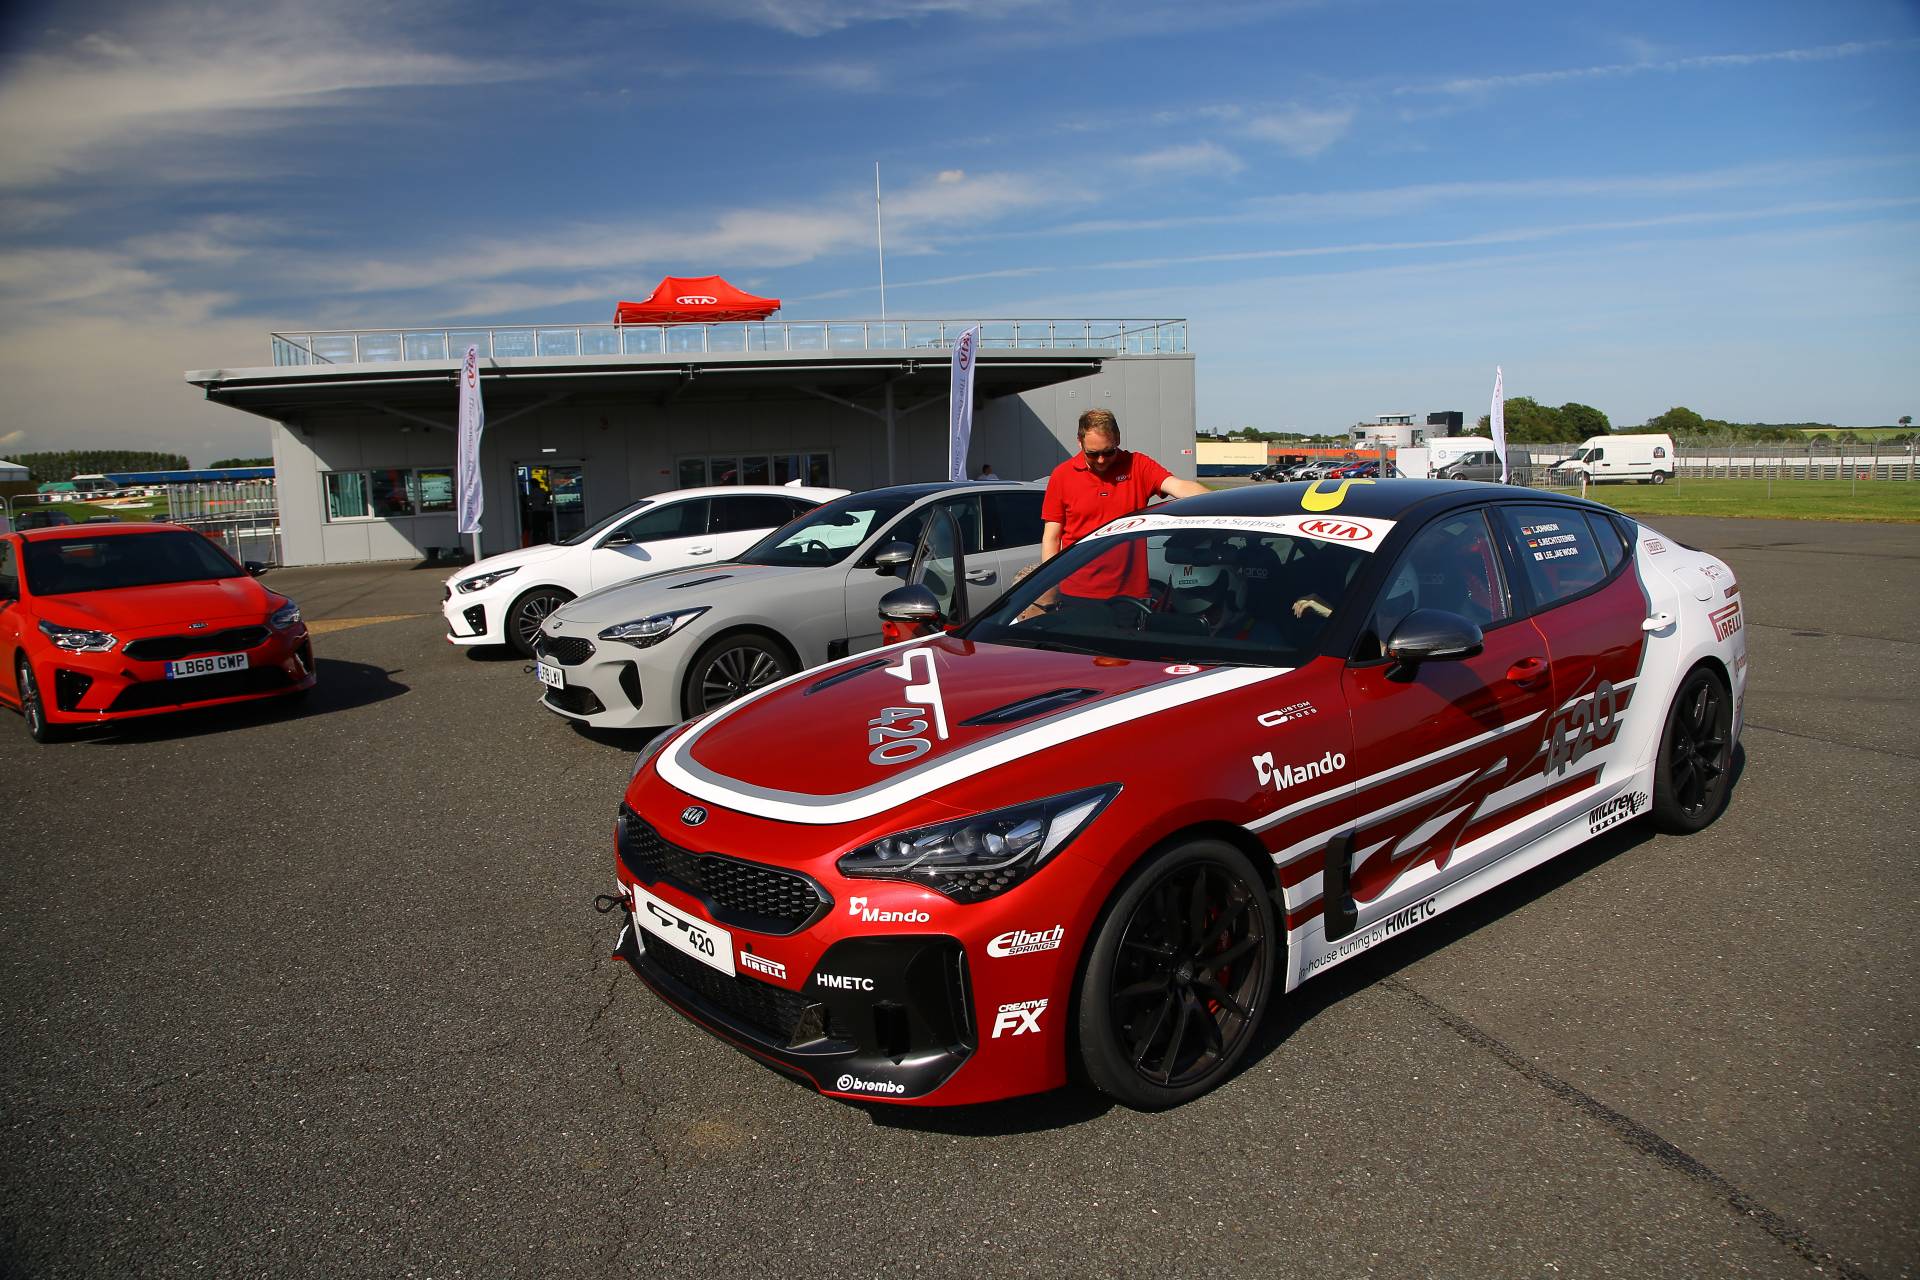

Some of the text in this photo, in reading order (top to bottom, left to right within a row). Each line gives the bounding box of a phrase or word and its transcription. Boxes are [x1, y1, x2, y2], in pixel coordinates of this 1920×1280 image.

[1231, 518, 1287, 529] Surprise
[1309, 521, 1358, 539] KIA
[1708, 601, 1742, 643] PIRELLI
[175, 654, 245, 676] LB68 GWP
[868, 706, 932, 766] 420
[1543, 679, 1617, 778] 420
[1272, 751, 1346, 792] Mando
[1590, 810, 1630, 835] SPORT
[861, 907, 930, 923] Mando
[1339, 934, 1370, 957] tuning
[1371, 927, 1384, 942] by
[1385, 897, 1437, 936] HMETC
[689, 930, 715, 957] 420
[986, 924, 1065, 958] Eibach
[1008, 940, 1057, 955] SPRINGS
[740, 950, 788, 981] PIRELLI
[816, 972, 875, 992] HMETC
[998, 999, 1049, 1013] CREATIVE
[991, 1006, 1047, 1039] FX
[852, 1077, 905, 1094] brembo
